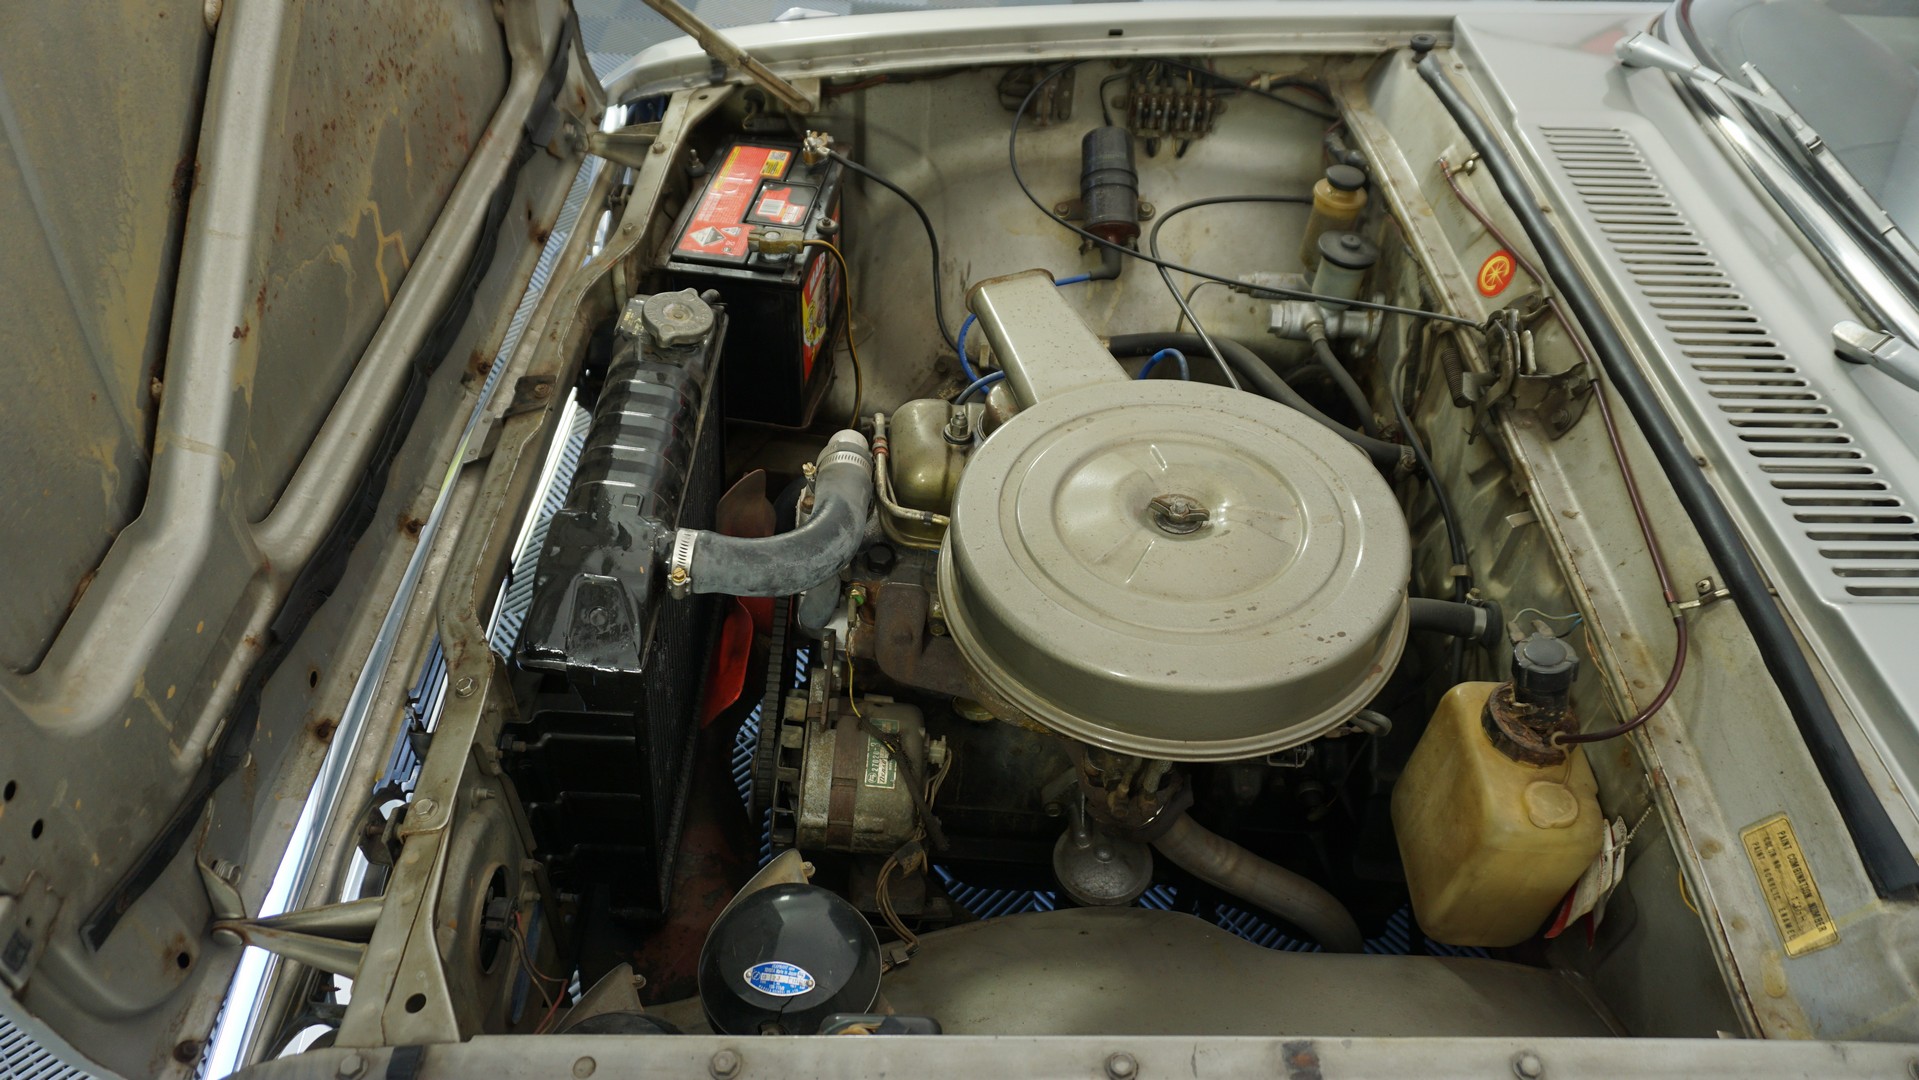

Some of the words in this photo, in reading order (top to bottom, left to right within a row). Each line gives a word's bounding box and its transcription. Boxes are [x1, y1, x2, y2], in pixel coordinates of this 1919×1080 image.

[1752, 842, 1765, 860] PAINT
[1762, 868, 1780, 901] ACRYLIC
[1778, 907, 1797, 940] ENAMEL
[1777, 830, 1792, 850] PAINT
[1787, 853, 1812, 898] COMBINATION
[1808, 902, 1827, 932] NUMBER
